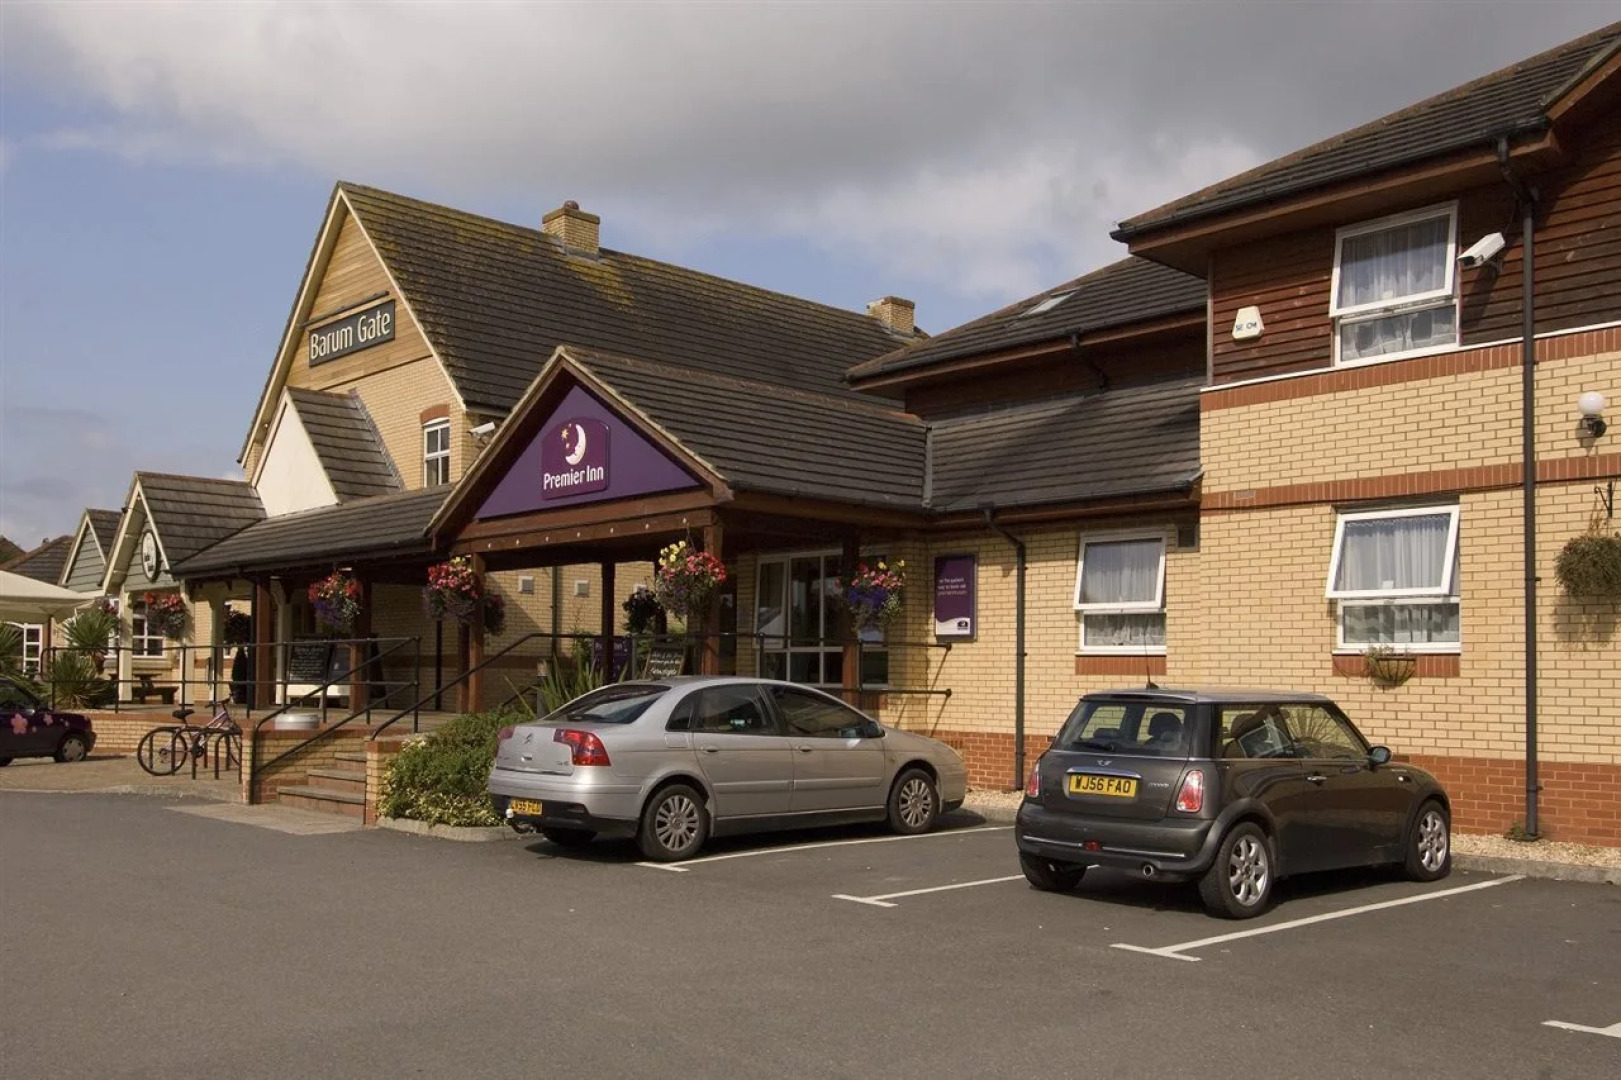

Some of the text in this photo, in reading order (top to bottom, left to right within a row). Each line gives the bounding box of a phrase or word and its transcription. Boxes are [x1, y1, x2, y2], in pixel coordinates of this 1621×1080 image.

[310, 310, 391, 360] Barum Gate
[543, 464, 604, 490] Premier Inn
[1074, 776, 1104, 791] WJ56
